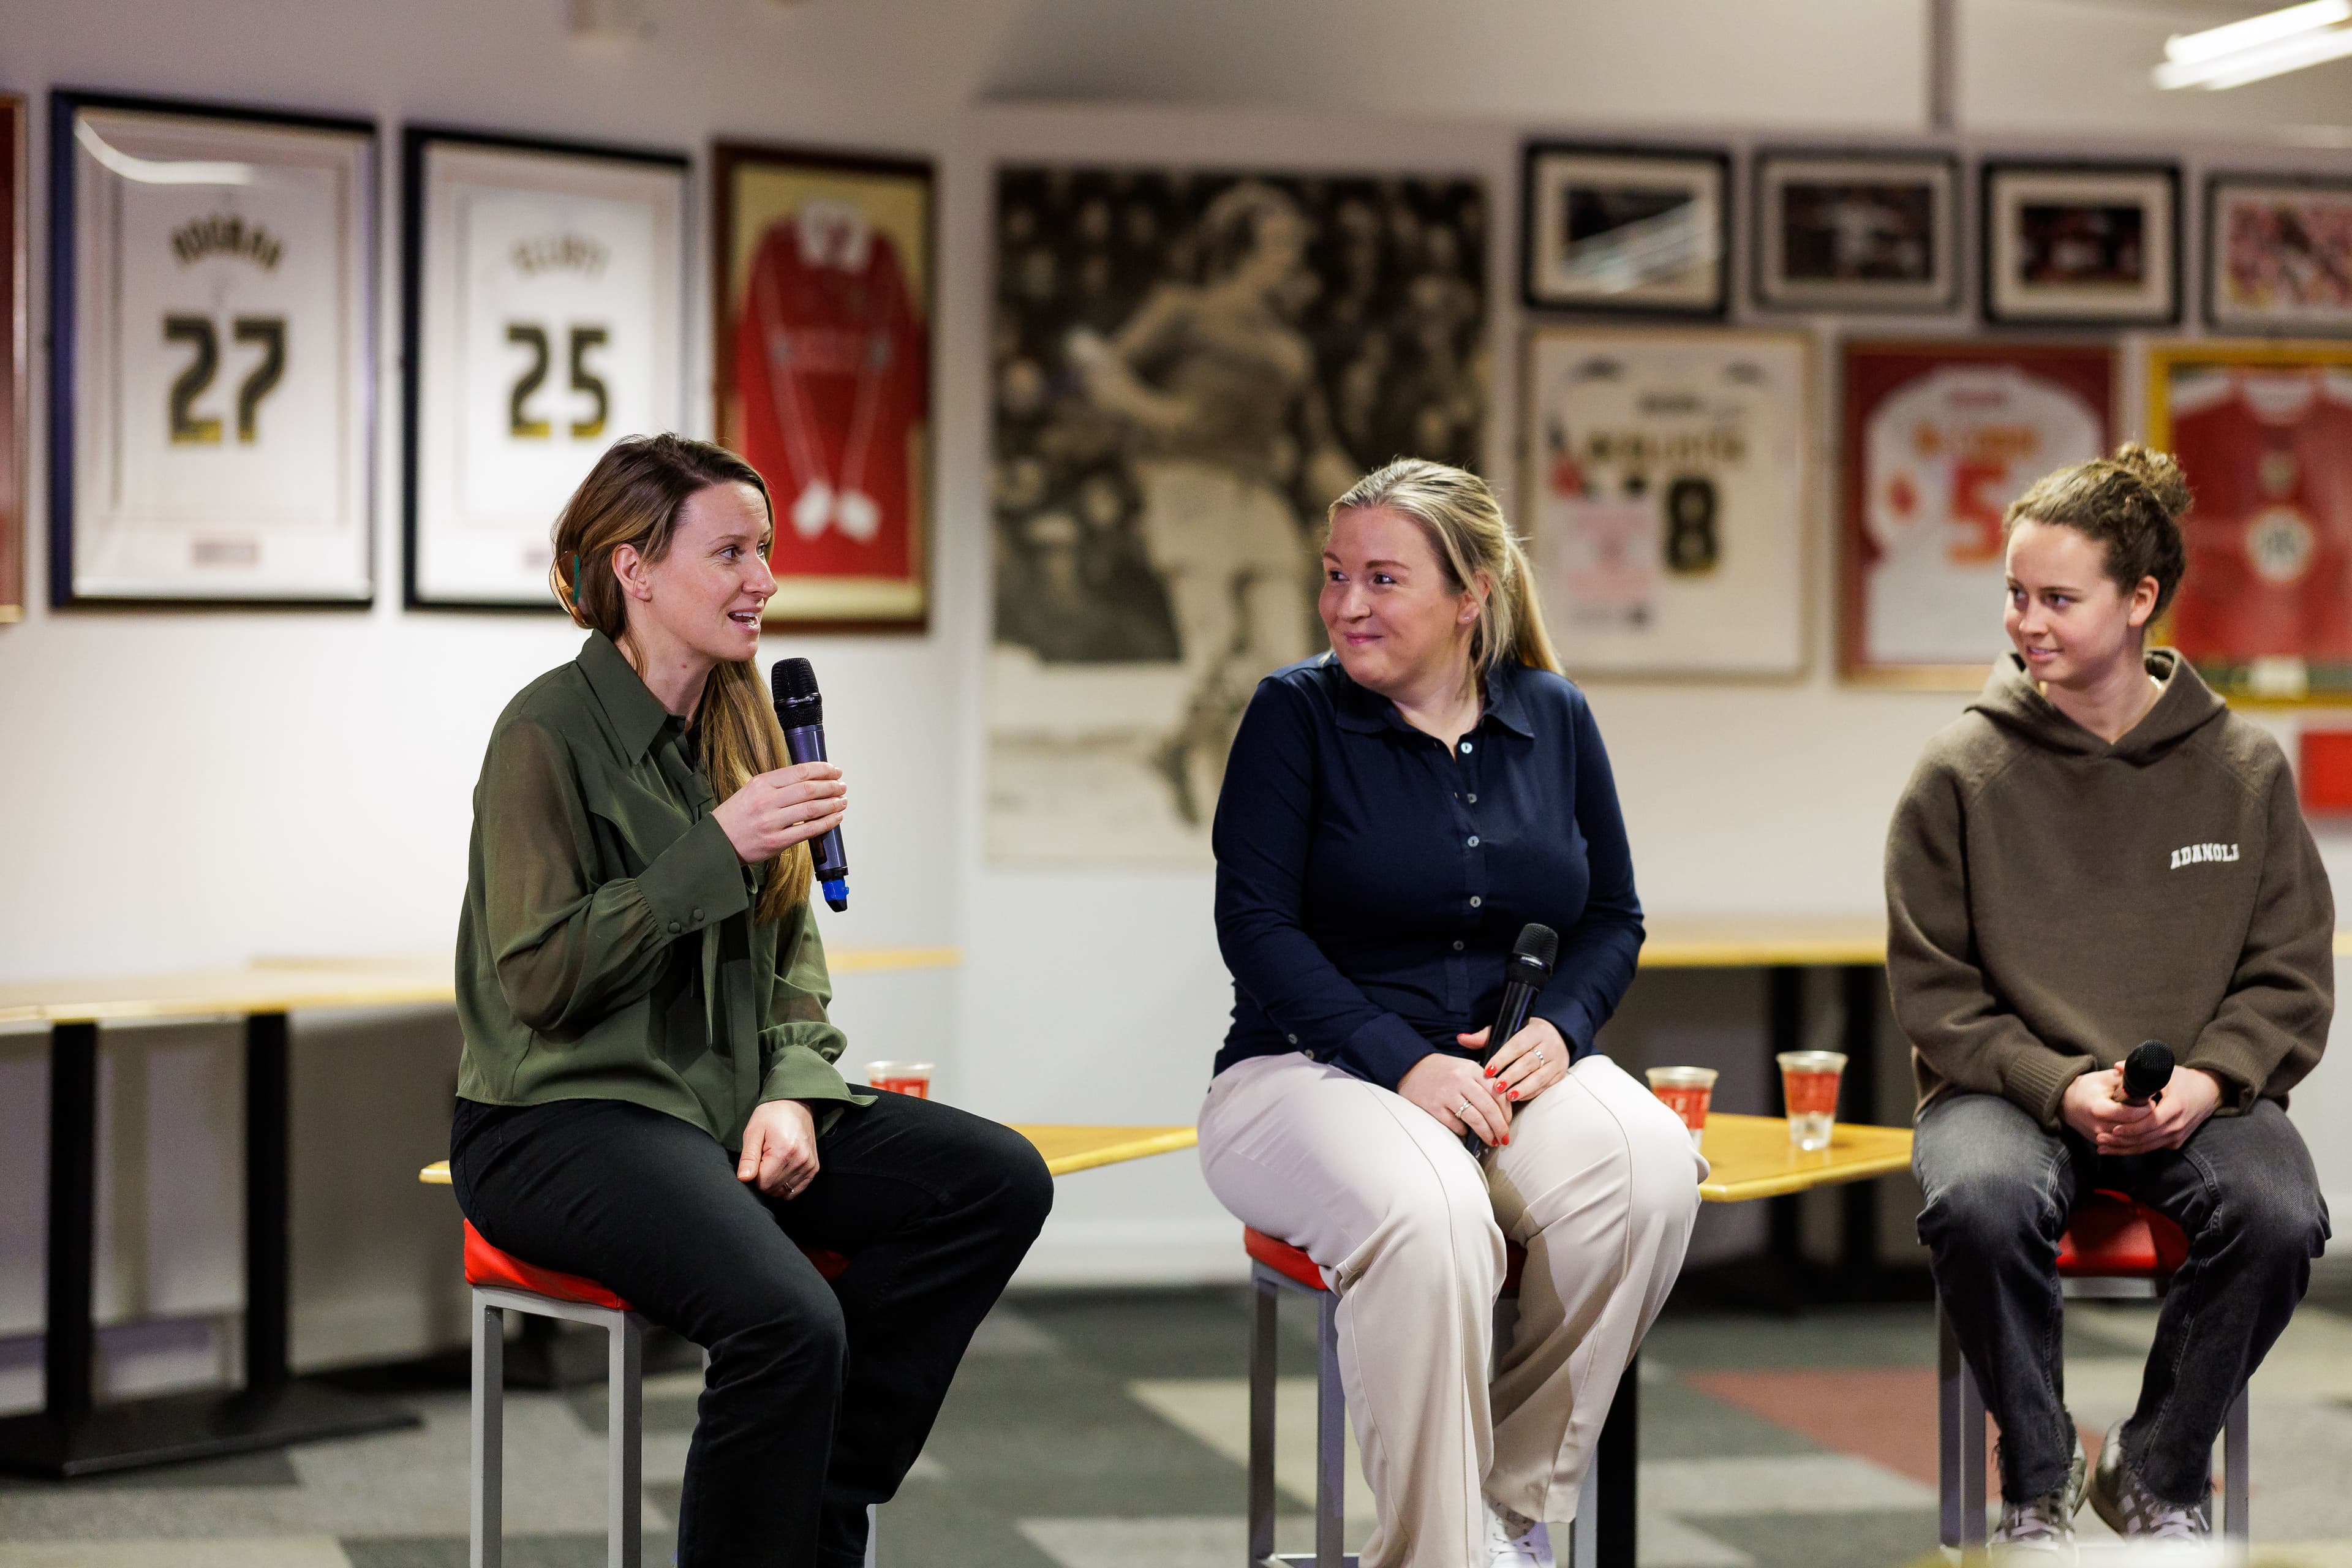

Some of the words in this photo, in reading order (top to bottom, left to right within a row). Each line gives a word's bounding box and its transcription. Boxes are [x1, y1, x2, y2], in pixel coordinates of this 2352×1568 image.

[164, 315, 285, 443] 27
[508, 326, 608, 437] 25
[1666, 477, 1719, 575] 8
